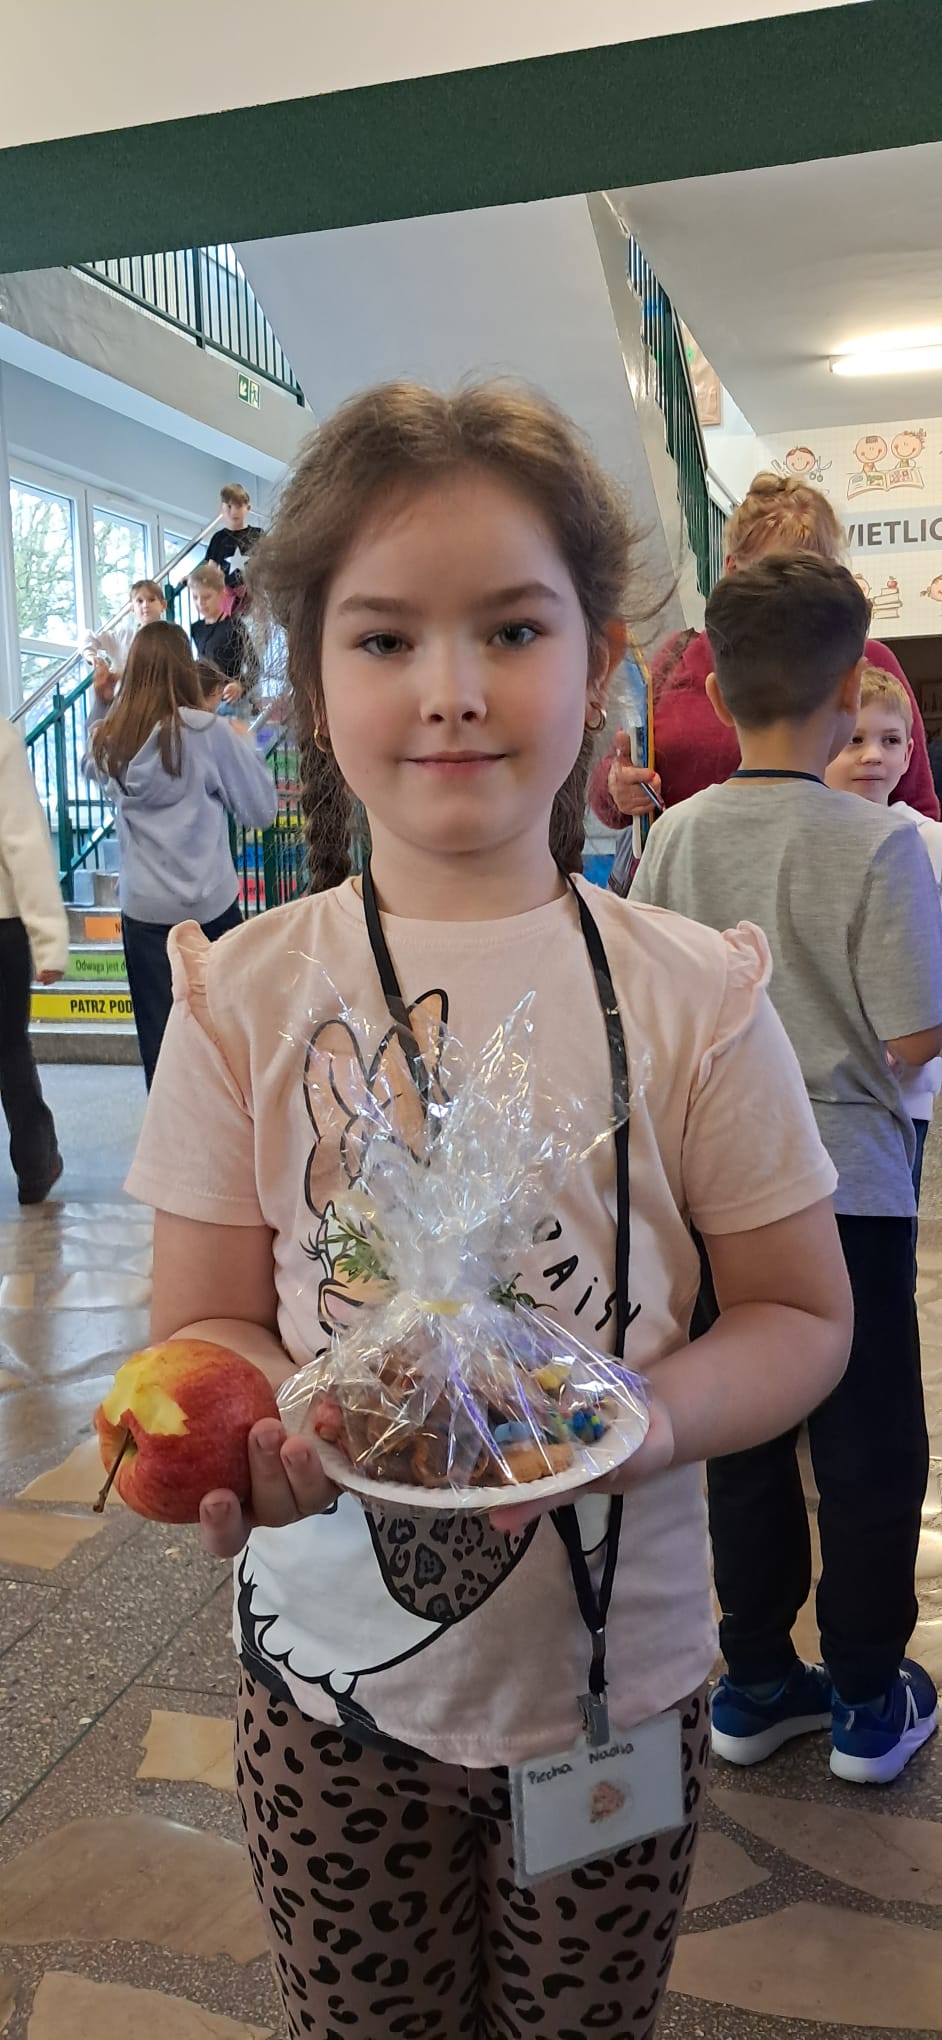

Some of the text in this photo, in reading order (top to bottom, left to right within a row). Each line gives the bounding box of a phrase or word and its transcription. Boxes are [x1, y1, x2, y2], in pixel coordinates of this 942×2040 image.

[75, 959, 105, 974] Odwaga
[70, 999, 133, 1014] PATRZ POD
